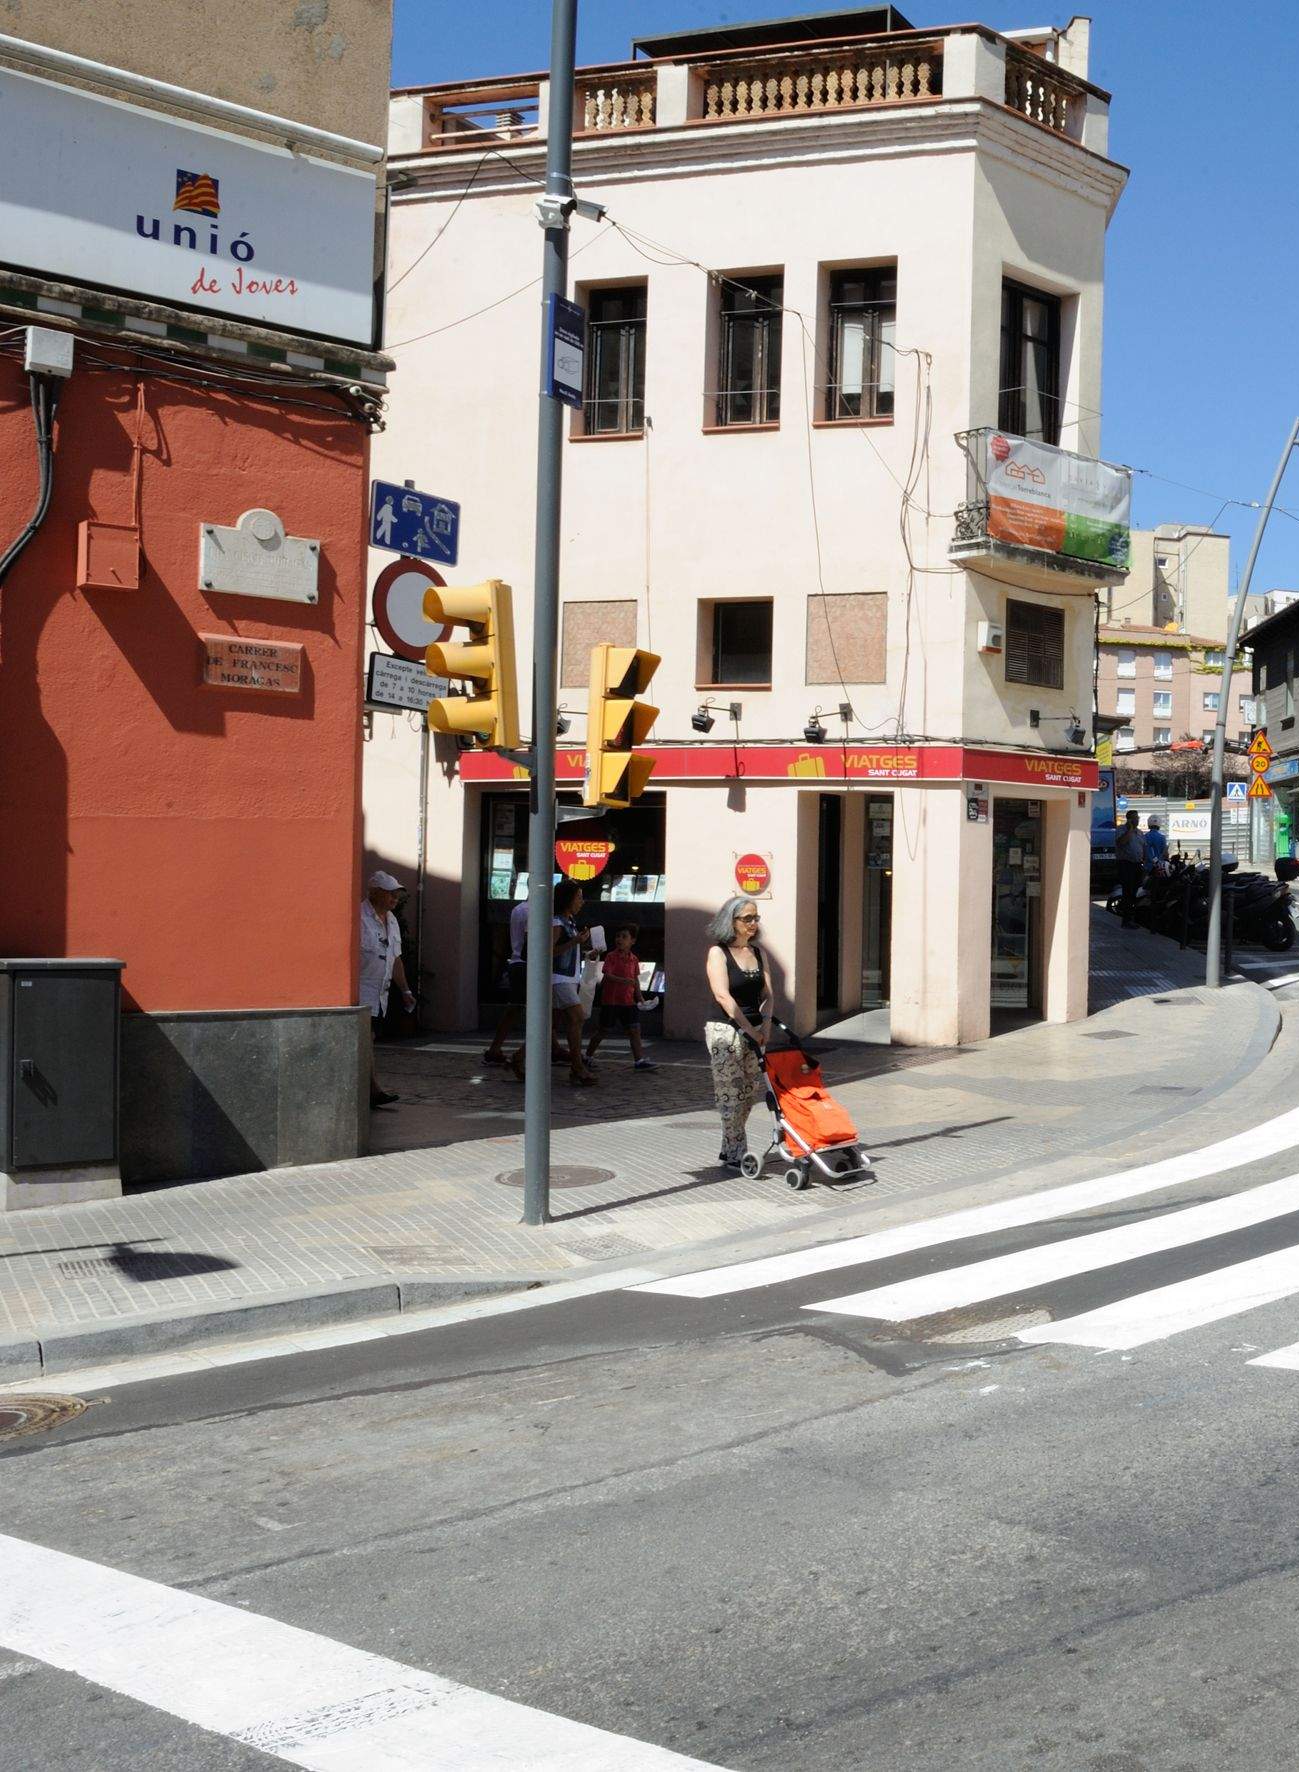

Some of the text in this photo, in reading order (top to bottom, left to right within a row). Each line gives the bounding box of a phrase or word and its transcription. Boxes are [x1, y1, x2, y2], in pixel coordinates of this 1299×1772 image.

[136, 214, 255, 262] unió
[191, 267, 298, 295] de Joves
[228, 643, 278, 658] CARRER
[207, 656, 298, 674] DE FRANCESC
[386, 661, 412, 673] Excepte
[221, 672, 281, 687] MORAGAS
[841, 754, 918, 769] VIATGES
[1024, 758, 1083, 775] VIATGES
[1255, 760, 1266, 768] 20
[867, 769, 918, 777] SANT CUGAT
[1045, 773, 1083, 783] SANT CUGAT
[560, 842, 607, 852] VIATGES
